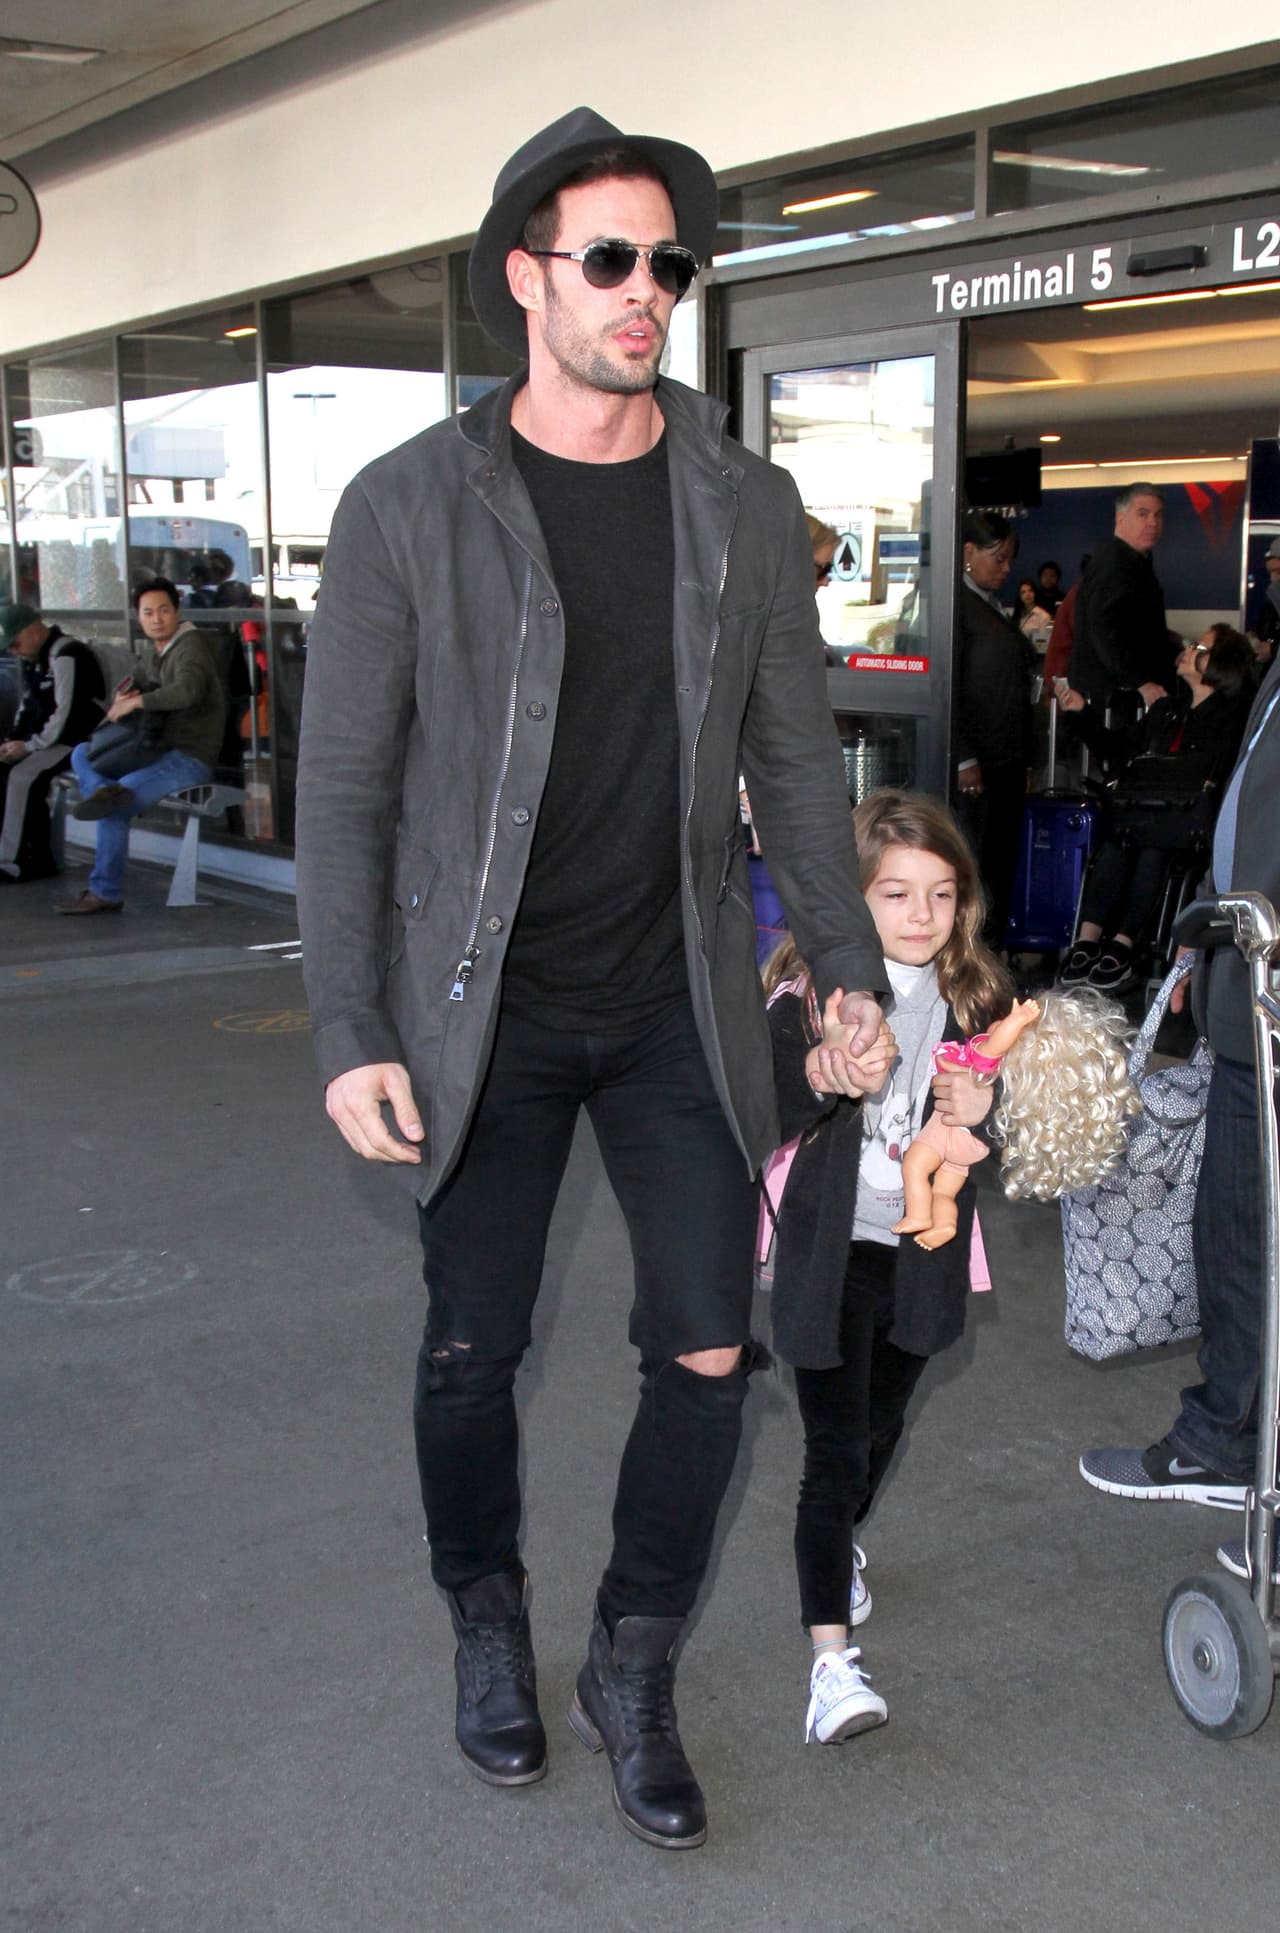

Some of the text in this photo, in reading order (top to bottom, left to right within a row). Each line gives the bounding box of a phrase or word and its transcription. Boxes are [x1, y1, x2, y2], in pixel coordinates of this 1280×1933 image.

[932, 248, 1113, 312] Terminal 5
[856, 658, 924, 671] AUTOMATIC SLIDING DOOR
